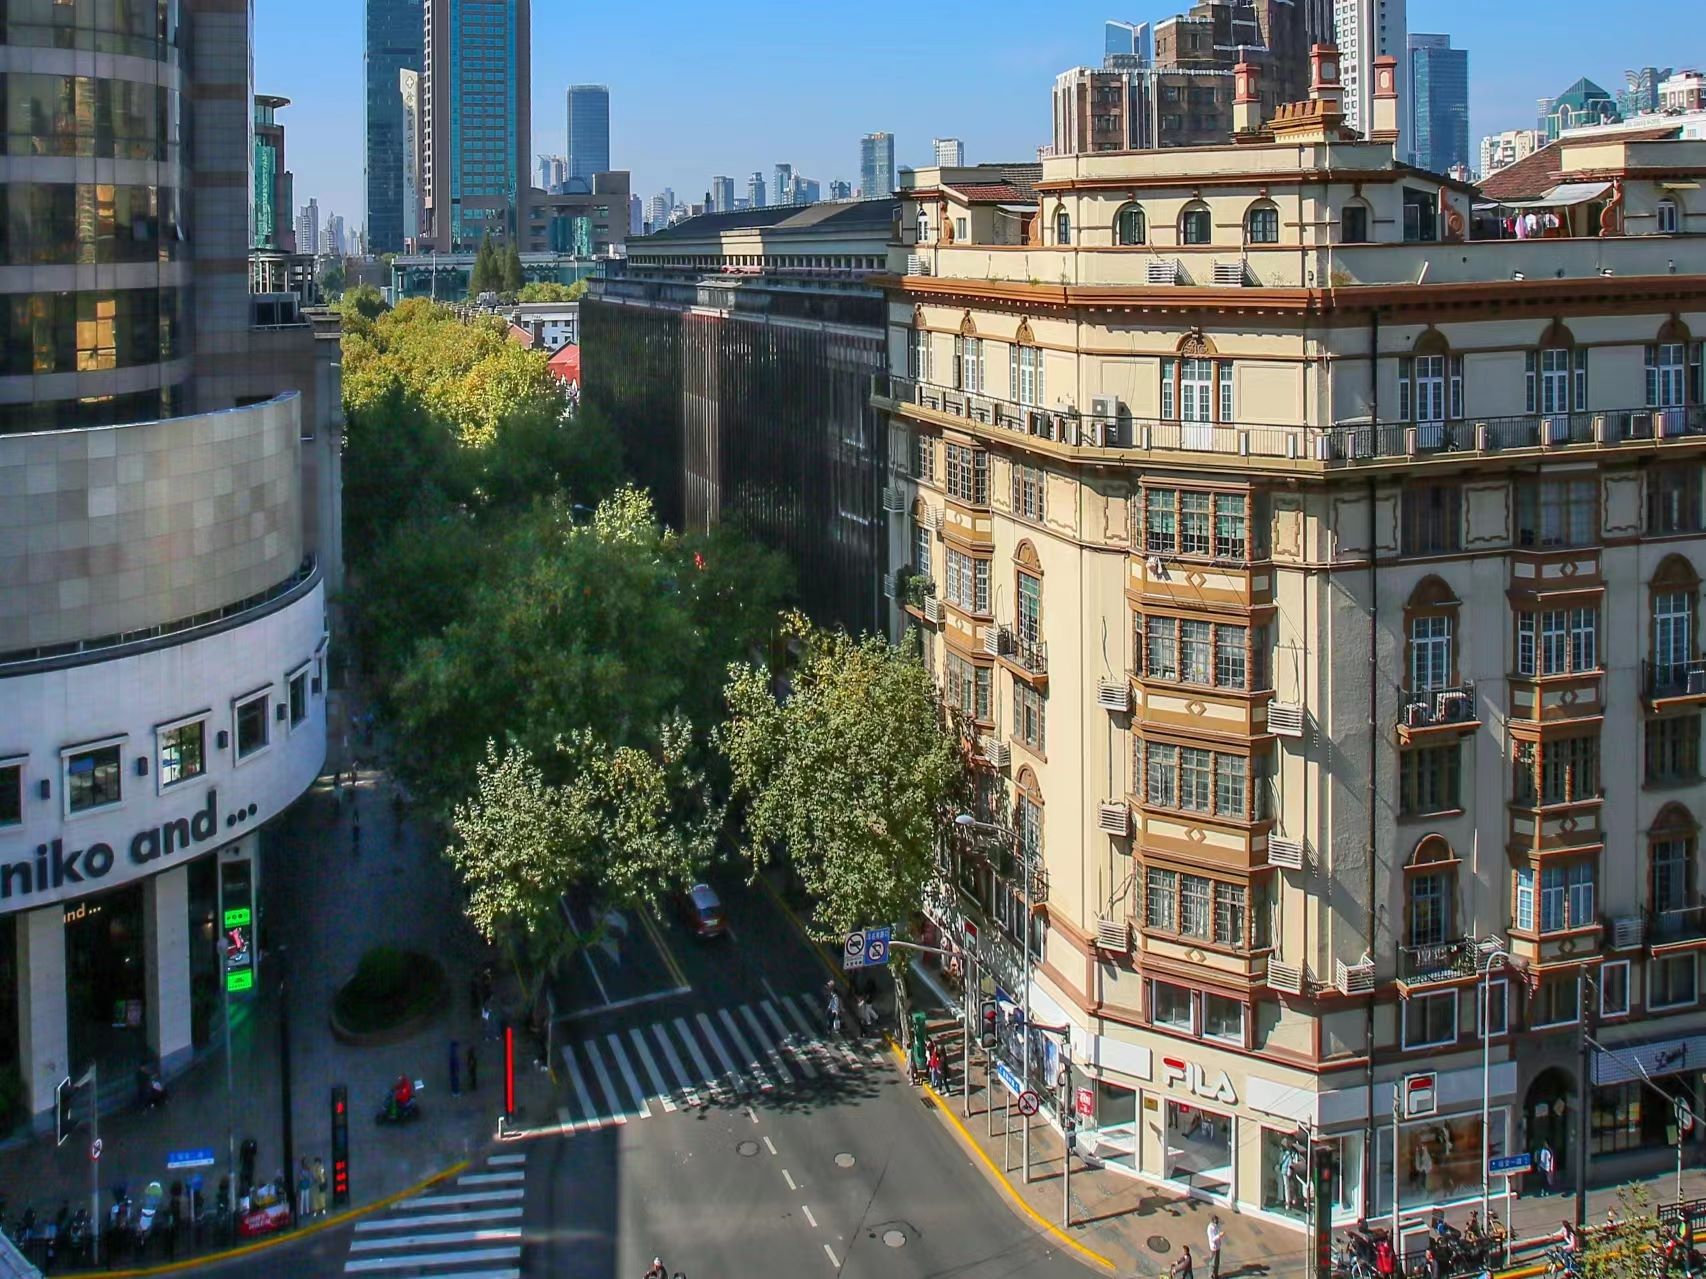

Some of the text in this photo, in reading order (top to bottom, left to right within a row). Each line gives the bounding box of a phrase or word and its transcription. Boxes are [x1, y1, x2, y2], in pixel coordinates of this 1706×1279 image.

[1, 839, 114, 897] niko
[131, 789, 217, 864] and
[1161, 1056, 1238, 1105] FILA
